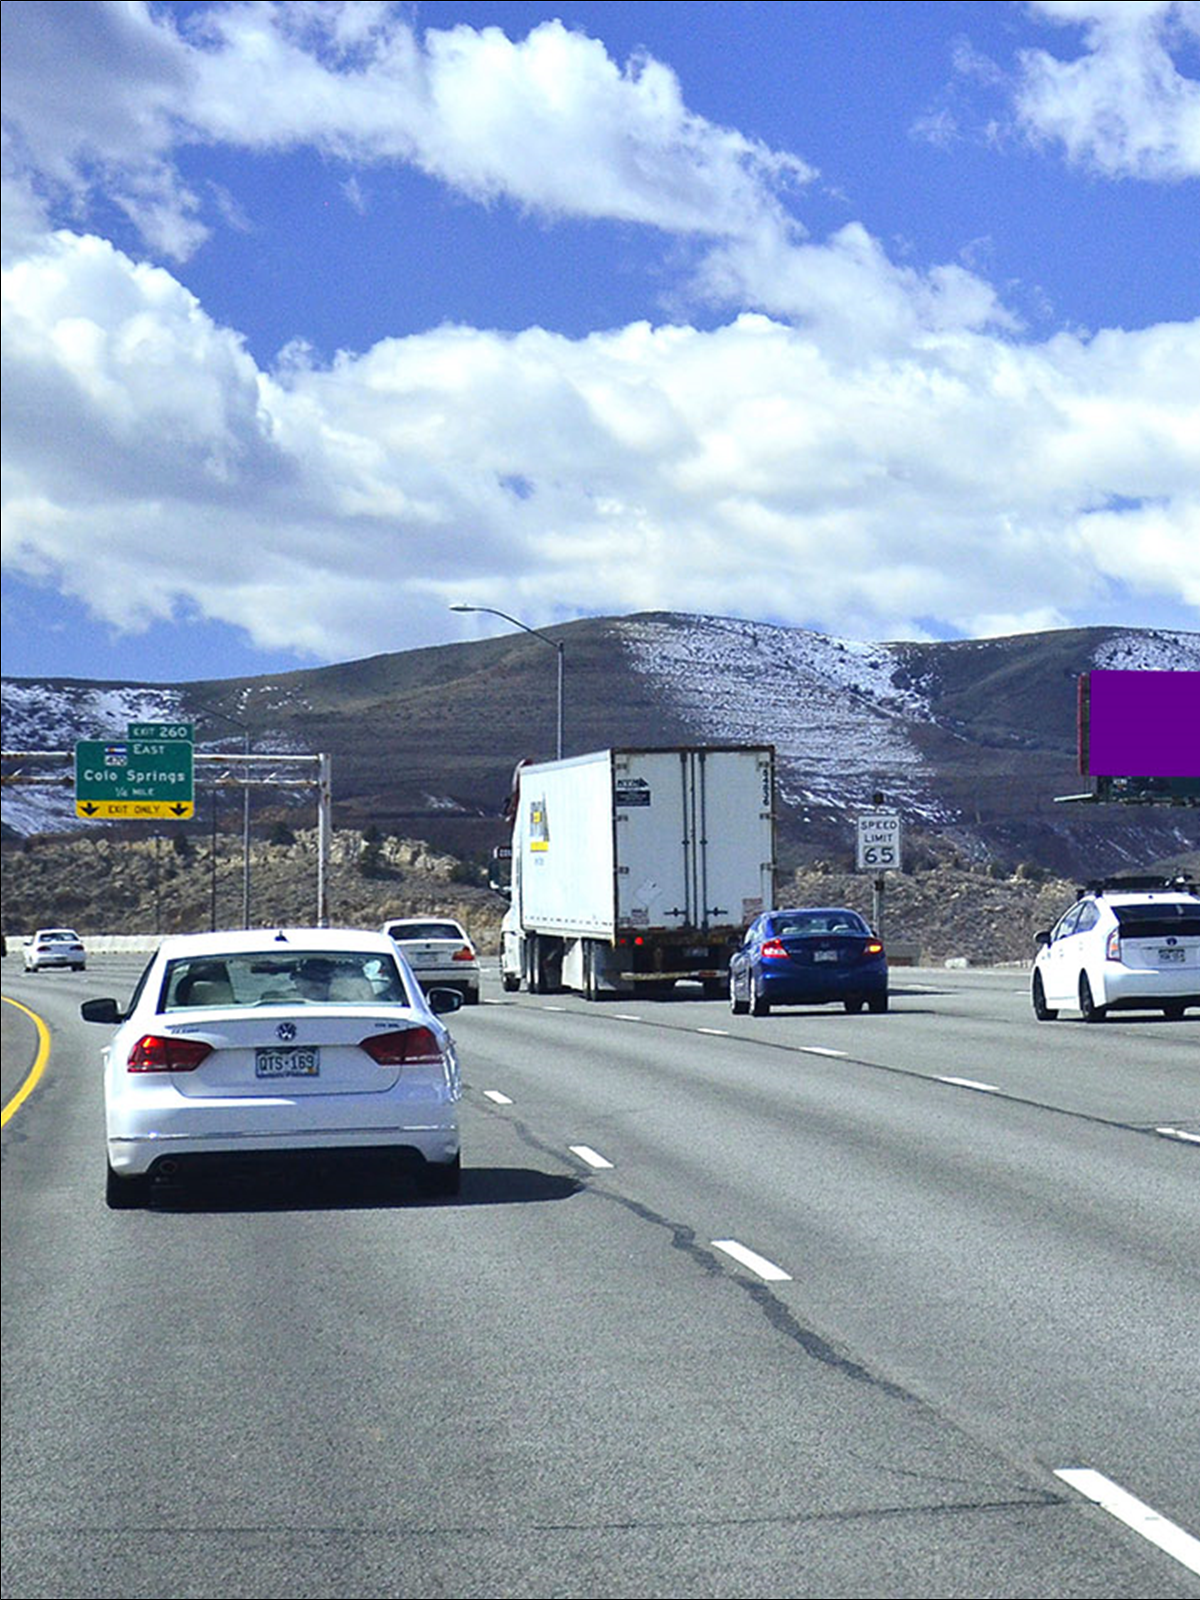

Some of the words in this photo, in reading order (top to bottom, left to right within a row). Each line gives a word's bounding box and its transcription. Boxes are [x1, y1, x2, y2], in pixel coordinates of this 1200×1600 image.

[133, 727, 155, 736] EXIT
[159, 726, 187, 738] 260
[132, 743, 165, 754] EAST
[83, 769, 118, 781] Colo
[126, 769, 186, 784] Springs
[132, 787, 154, 796] MILE
[108, 805, 128, 814] EXIT
[134, 805, 160, 814] ONLY
[861, 820, 897, 830] SPEED
[864, 834, 893, 843] LIMIT
[864, 847, 894, 864] 65
